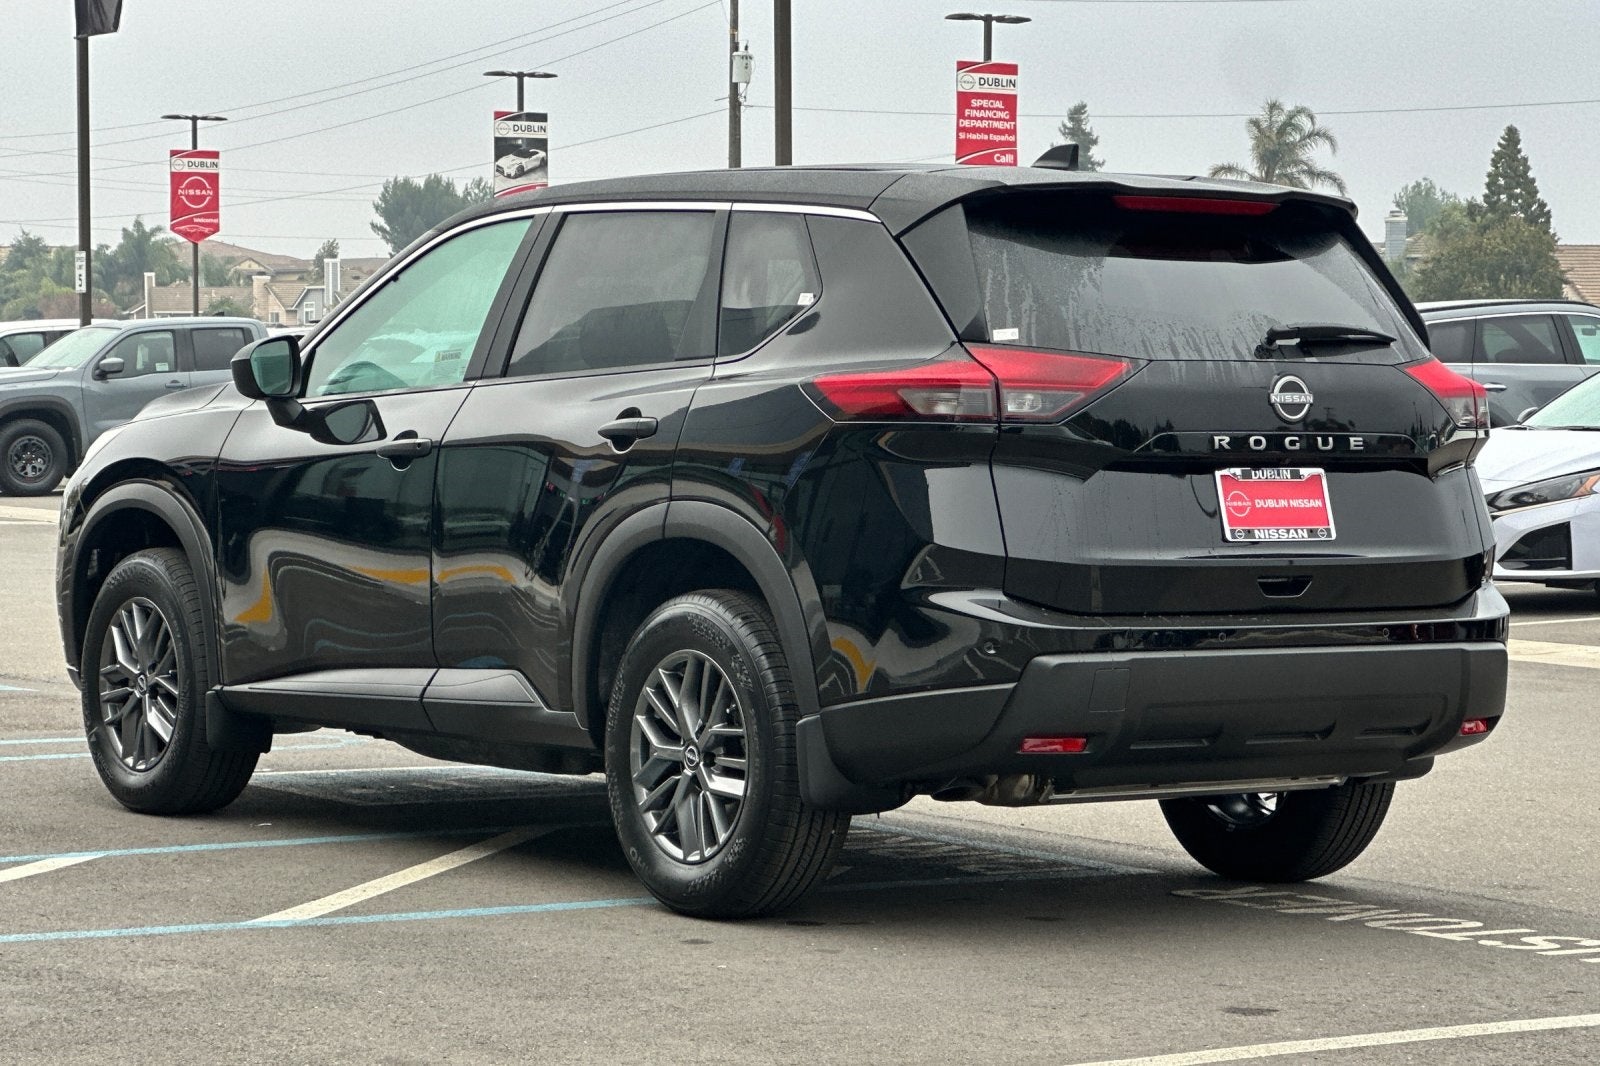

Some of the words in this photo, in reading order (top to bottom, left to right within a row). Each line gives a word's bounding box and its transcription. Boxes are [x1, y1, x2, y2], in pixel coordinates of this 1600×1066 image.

[978, 77, 1016, 88] DUBLIN
[971, 99, 1004, 108] SPECIAL
[965, 109, 1009, 119] FINANCING
[513, 124, 546, 133] DUBLIN
[959, 119, 1015, 129] DEPARTMENT
[990, 134, 1015, 142] Español
[1213, 436, 1364, 450] ROGUE
[1251, 469, 1291, 480] DUBLIN
[1255, 499, 1288, 508] DUBLIN
[1290, 500, 1322, 508] NISSAN
[1254, 529, 1308, 539] NISSAN
